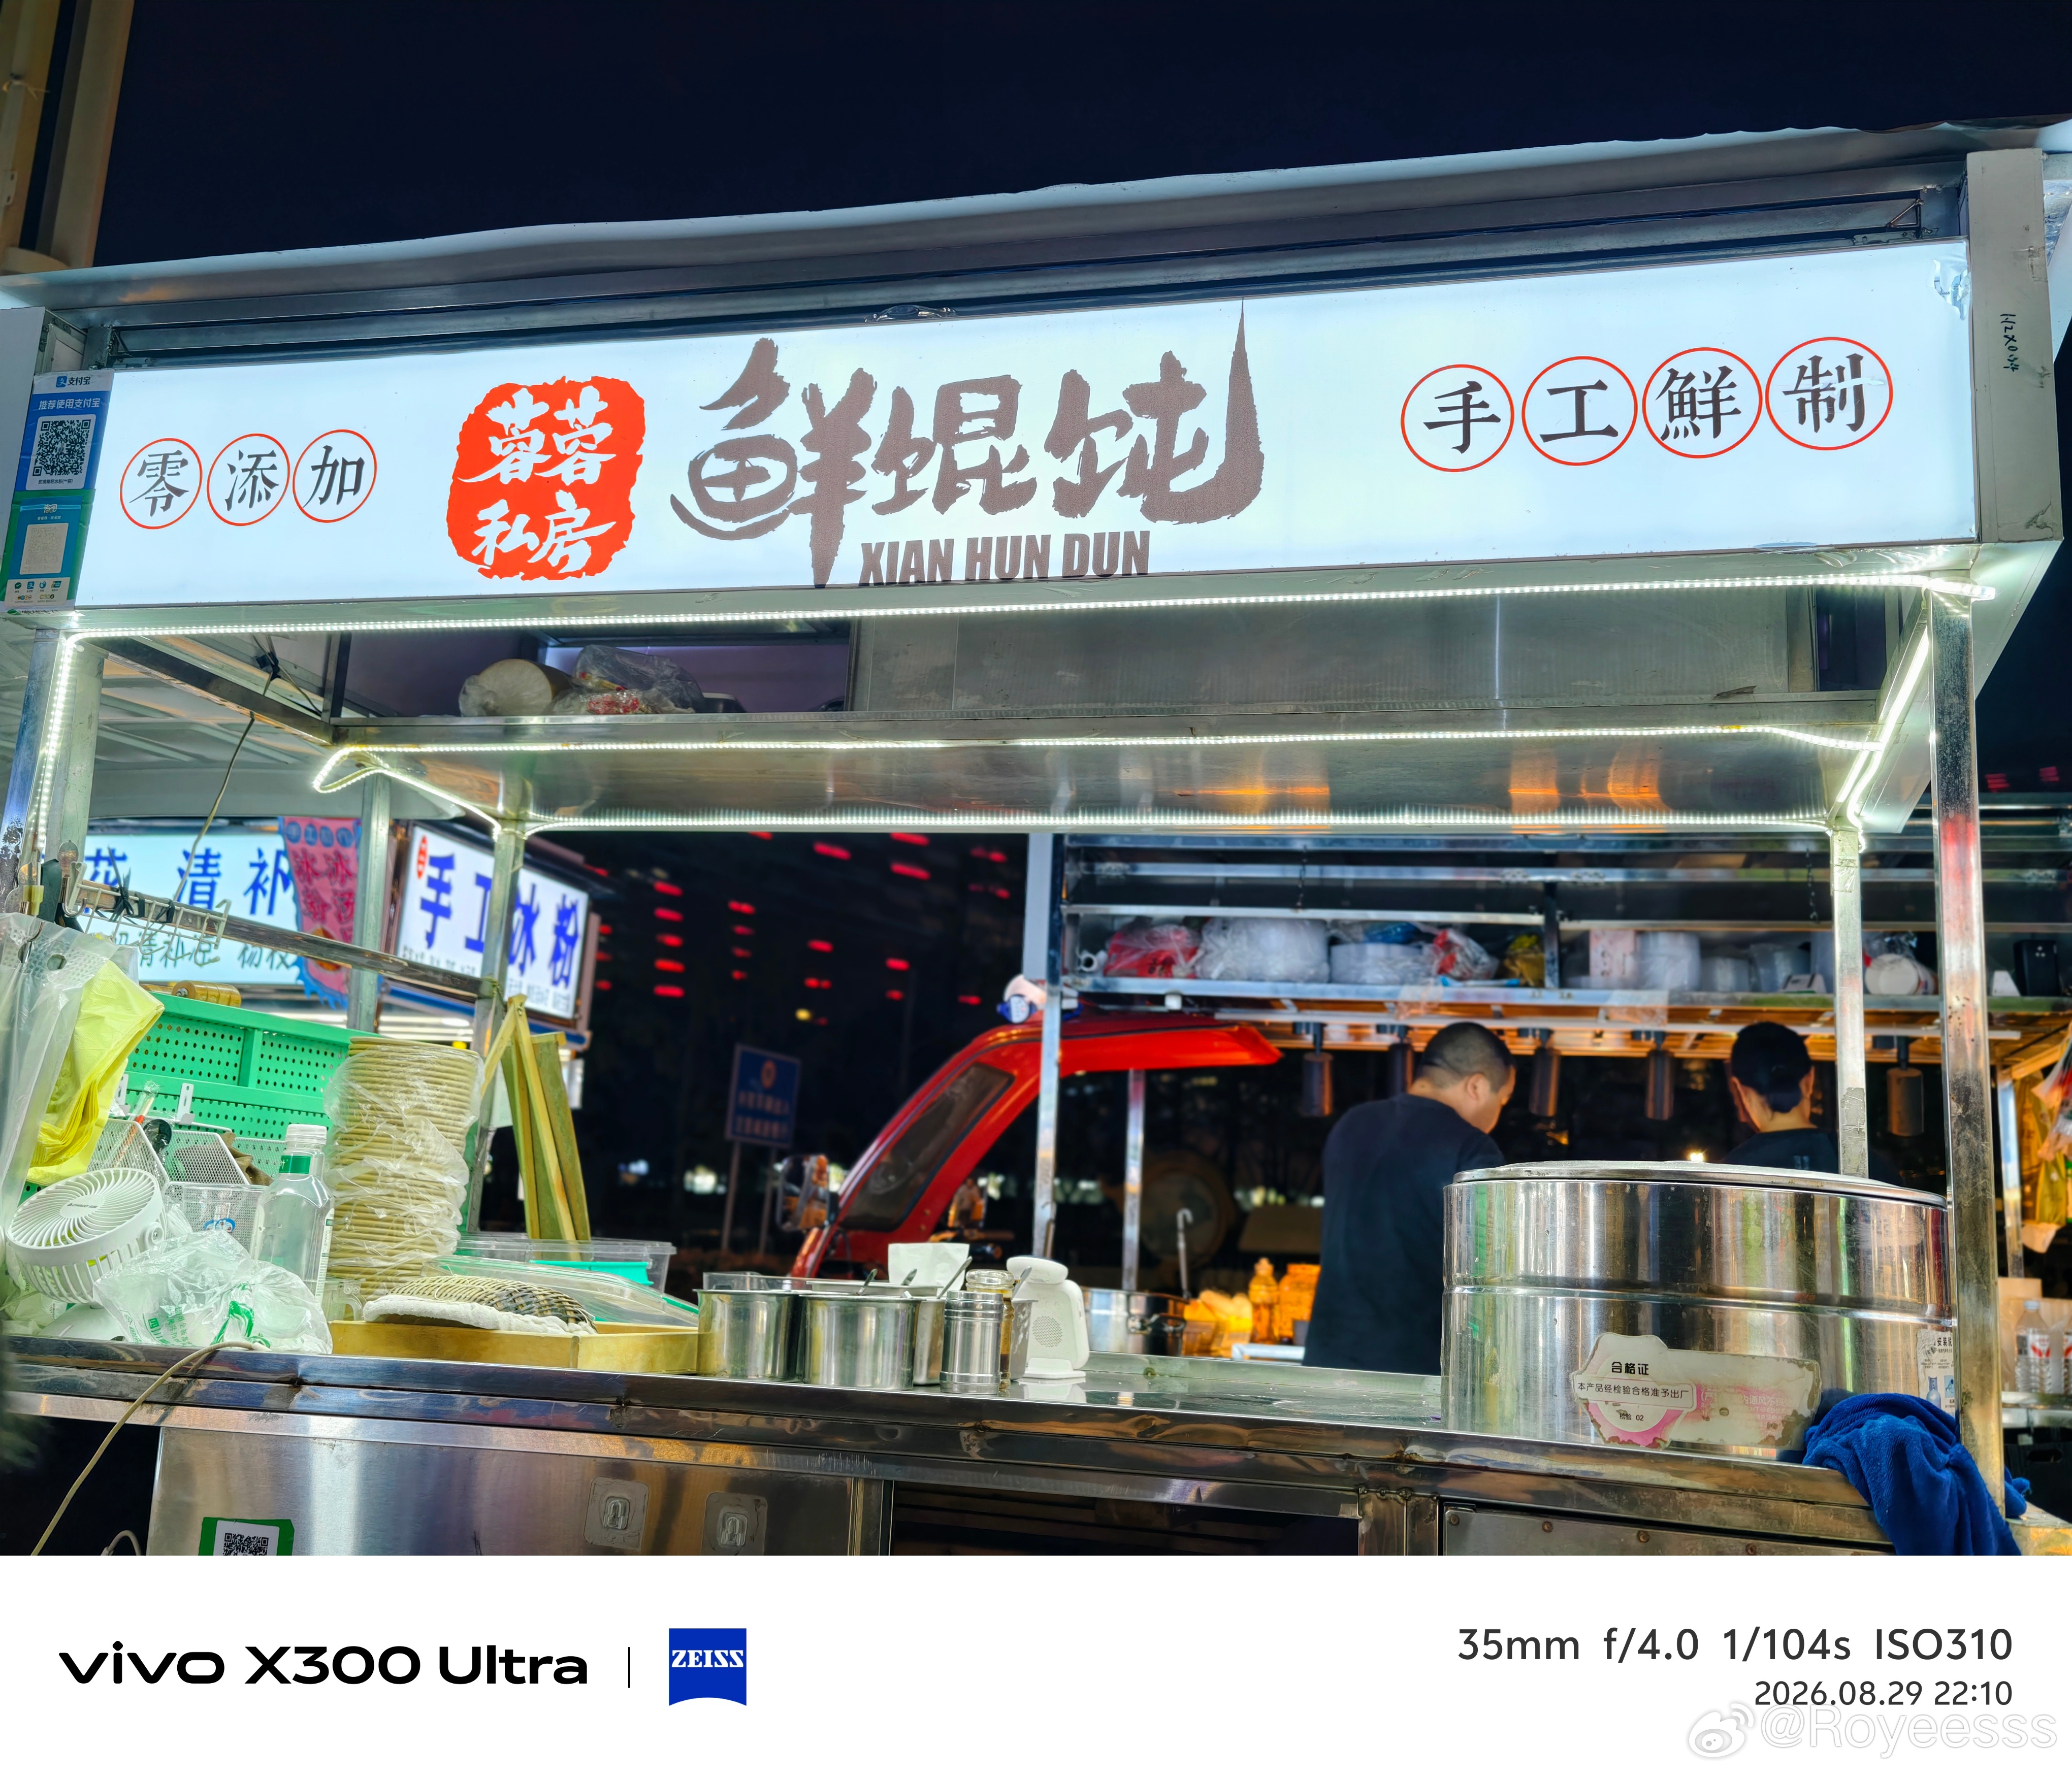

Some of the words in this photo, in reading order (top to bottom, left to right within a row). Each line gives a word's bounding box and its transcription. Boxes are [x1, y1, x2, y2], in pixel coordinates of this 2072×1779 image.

[38, 398, 101, 410] 推荐使用支付宝
[68, 376, 91, 385] 支付宝
[458, 385, 616, 485] 蓉蓉
[670, 298, 1265, 588] 鲜馄饨
[128, 445, 365, 517] 零添加
[472, 490, 616, 574] 私房
[859, 538, 954, 586] XIAN
[965, 534, 1051, 581] HUN
[1062, 530, 1150, 578] DUN
[1577, 1382, 1689, 1399] 本产品经检验合格准予出厂
[1611, 1361, 1649, 1375] 合格证
